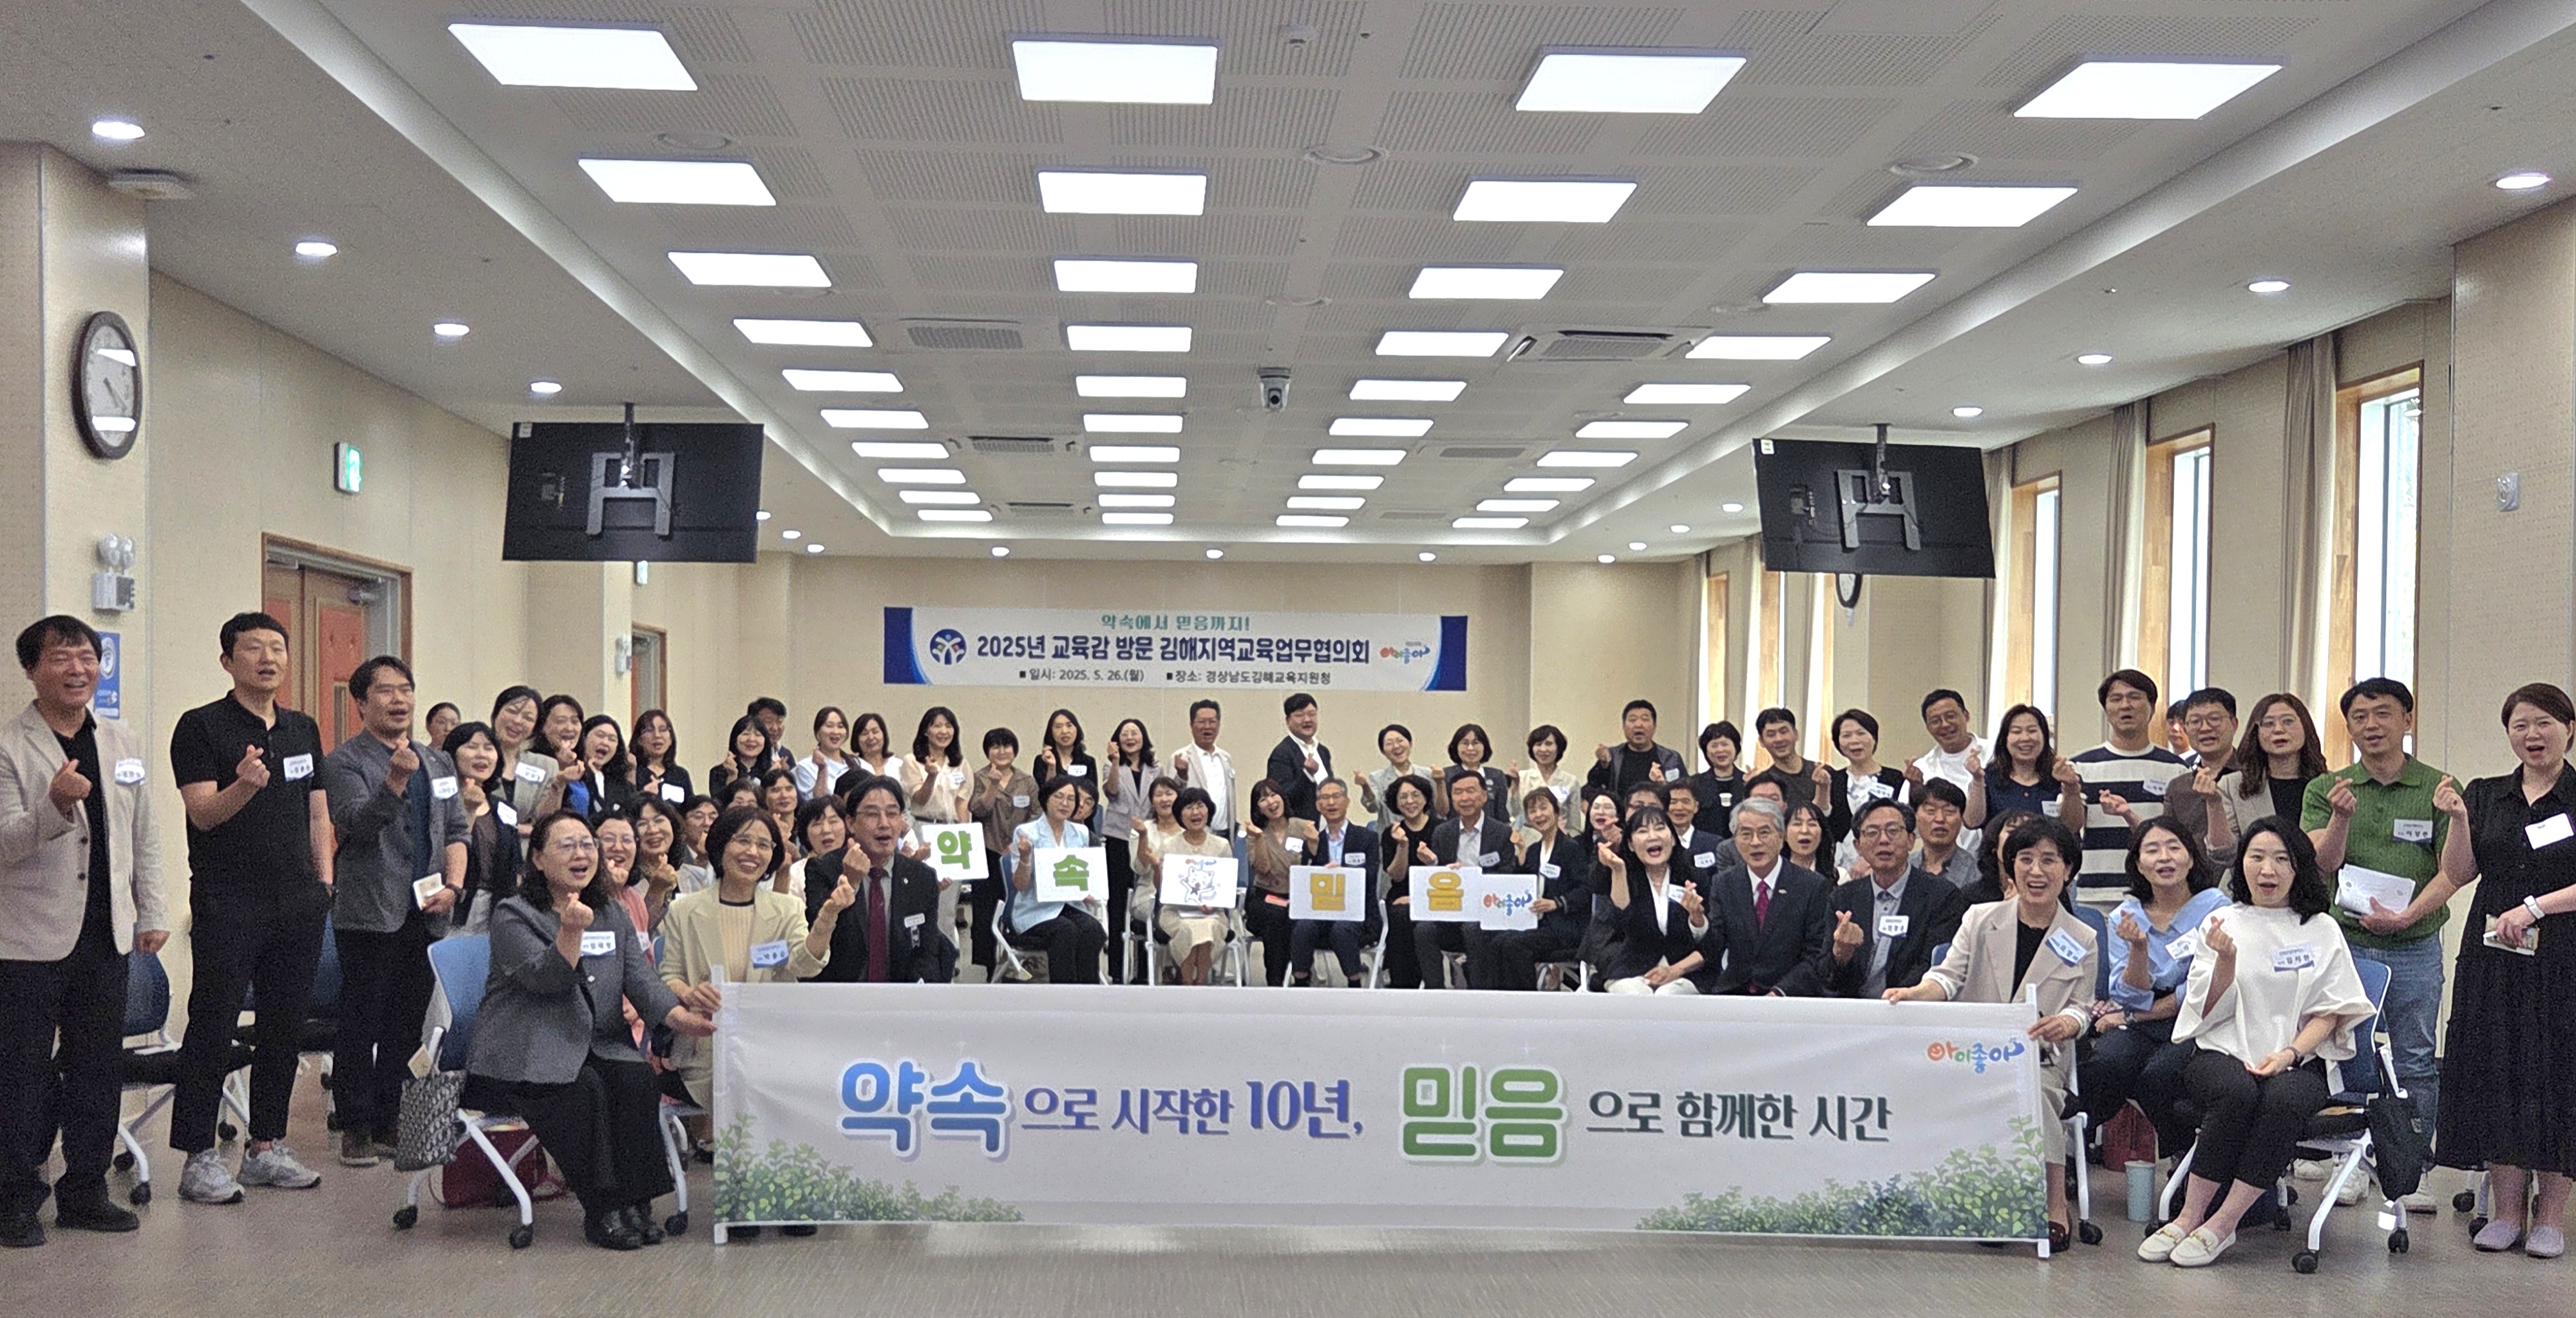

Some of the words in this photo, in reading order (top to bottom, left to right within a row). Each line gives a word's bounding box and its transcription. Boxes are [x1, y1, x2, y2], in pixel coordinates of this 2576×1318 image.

[977, 634, 1046, 659] 2025년
[1051, 634, 1111, 660] 교육감
[1115, 635, 1153, 661] 방문
[1159, 636, 1370, 664] 김해지역교육업무협의회
[1029, 668, 1056, 681] 일시:
[1059, 669, 1090, 681] 2025.
[1175, 671, 1202, 683] 장소:
[1206, 671, 1331, 684] 경상남도김해교육지원청
[936, 830, 973, 870] 약
[1052, 854, 1090, 892] 속
[1426, 871, 1464, 912] 음
[1927, 1037, 2025, 1074] 아이좋아
[839, 1059, 1009, 1155] 약속
[1021, 1087, 1100, 1131] 으로
[1111, 1088, 1235, 1135] 시작한
[1245, 1079, 1364, 1140] 10년,
[1401, 1064, 1566, 1161] 믿음
[1586, 1090, 1664, 1133] 으로
[1674, 1091, 1799, 1139] 함께한
[1808, 1095, 1893, 1142] 시간
